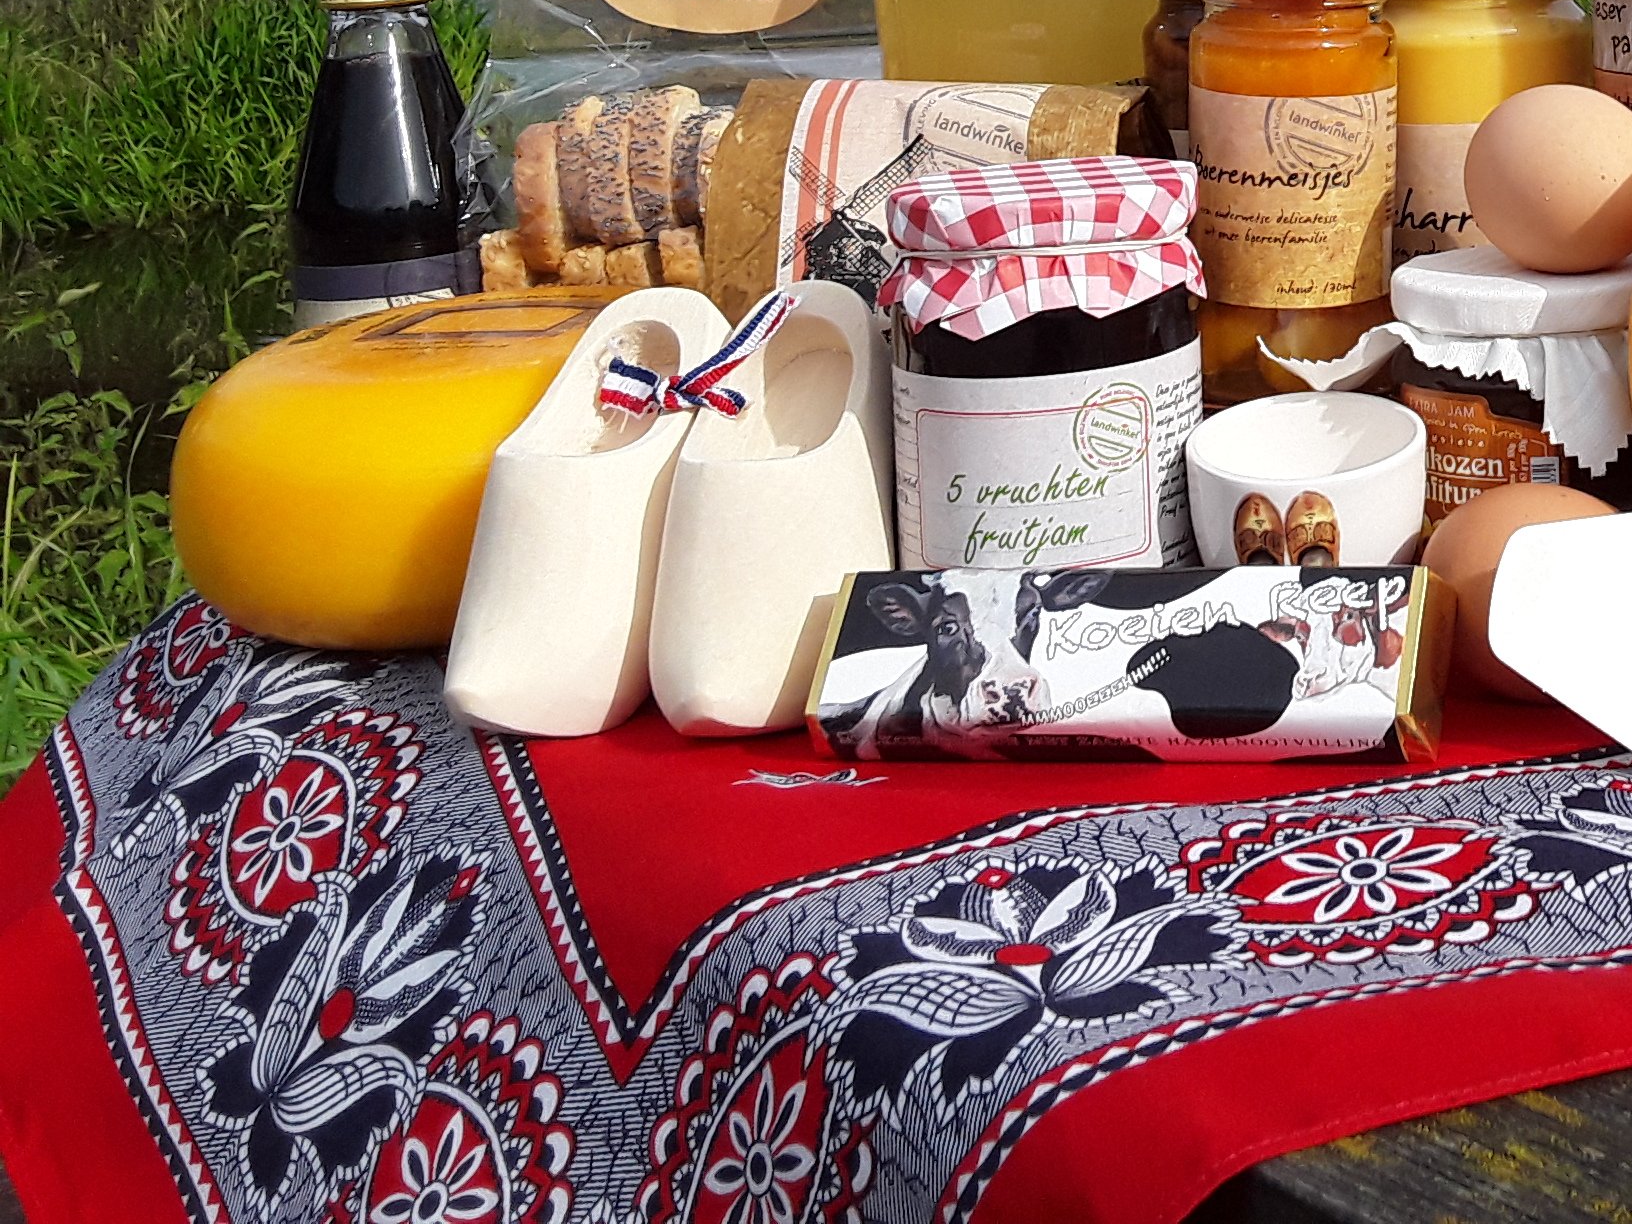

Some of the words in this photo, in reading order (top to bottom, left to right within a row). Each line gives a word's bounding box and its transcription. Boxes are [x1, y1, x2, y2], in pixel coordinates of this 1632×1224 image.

[933, 112, 1028, 156] landwinke
[1289, 110, 1362, 143] landwinkel
[1276, 209, 1338, 226] delicatesse
[1245, 229, 1329, 248] boerenfamilie
[1447, 405, 1476, 419] JAM
[946, 474, 966, 504] 5
[976, 464, 1110, 506] vruchten
[964, 511, 1089, 565] fruitjam
[1046, 601, 1241, 661] Koeien
[1268, 576, 1406, 632] Reep
